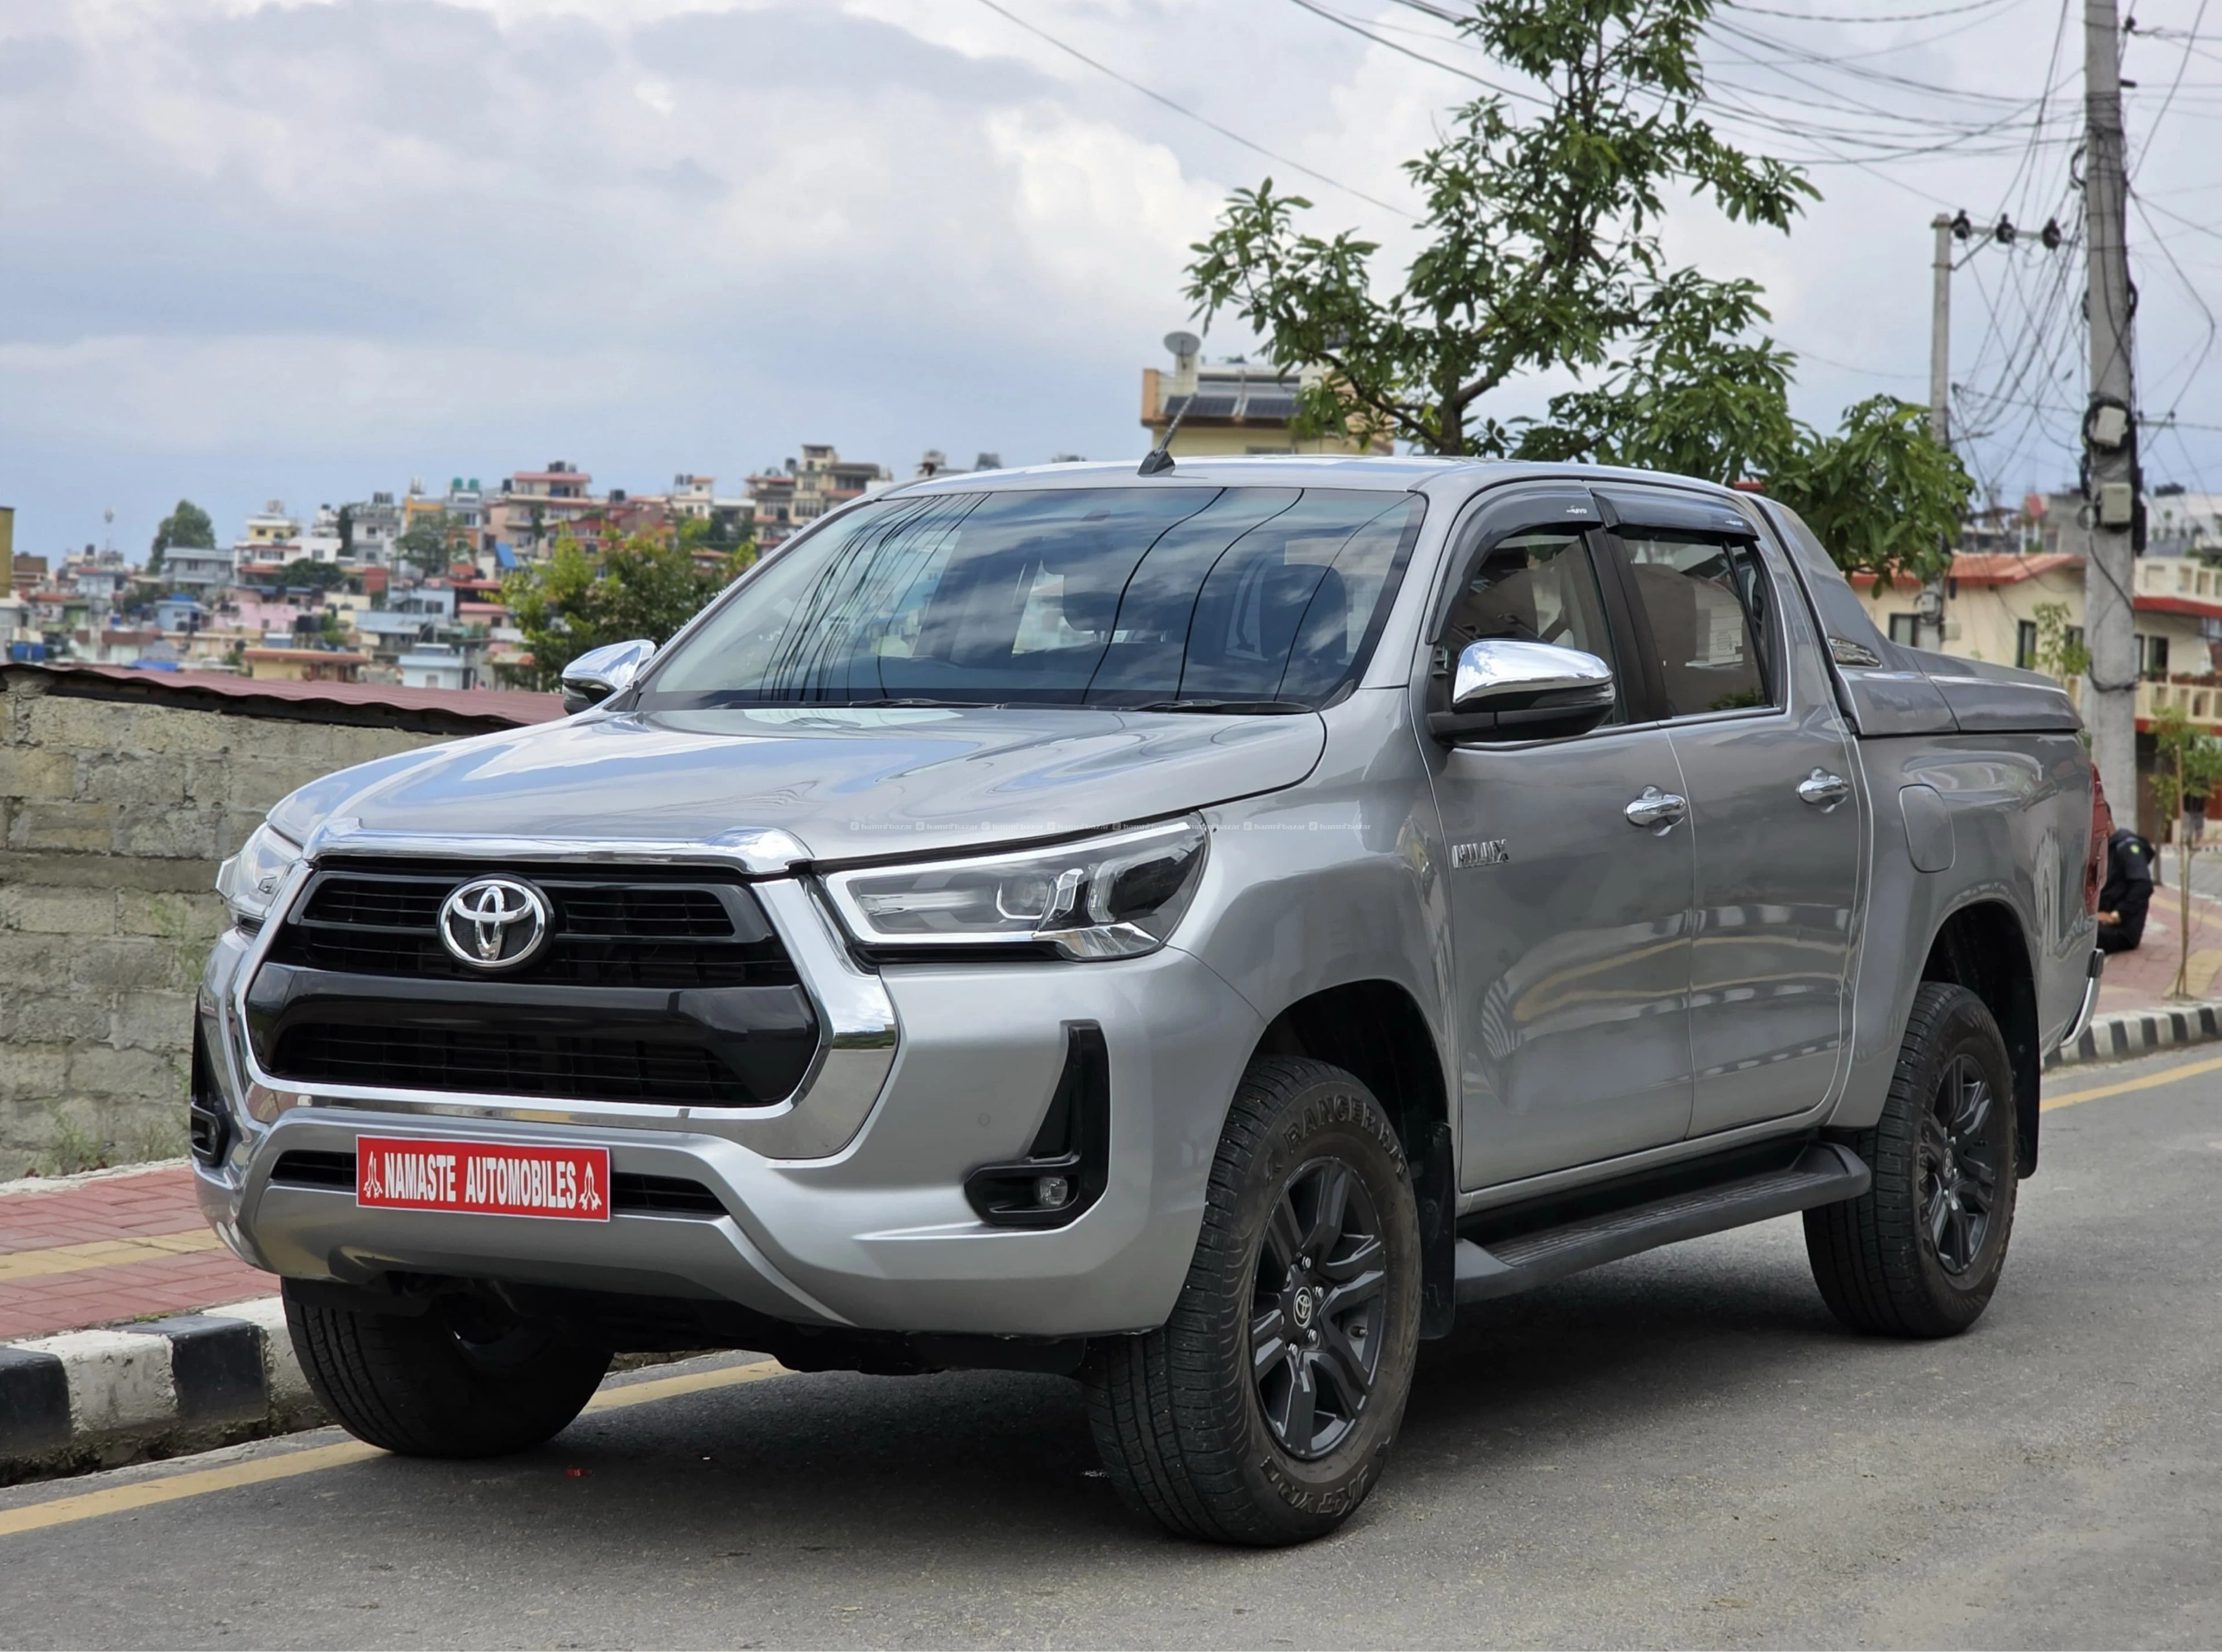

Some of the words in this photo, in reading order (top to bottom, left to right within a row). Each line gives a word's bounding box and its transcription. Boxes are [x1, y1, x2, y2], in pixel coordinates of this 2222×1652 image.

[1282, 1094, 1377, 1154] RANGER
[384, 1152, 456, 1202] NAMASTE
[465, 1156, 576, 1209] AUTOMOBILES
